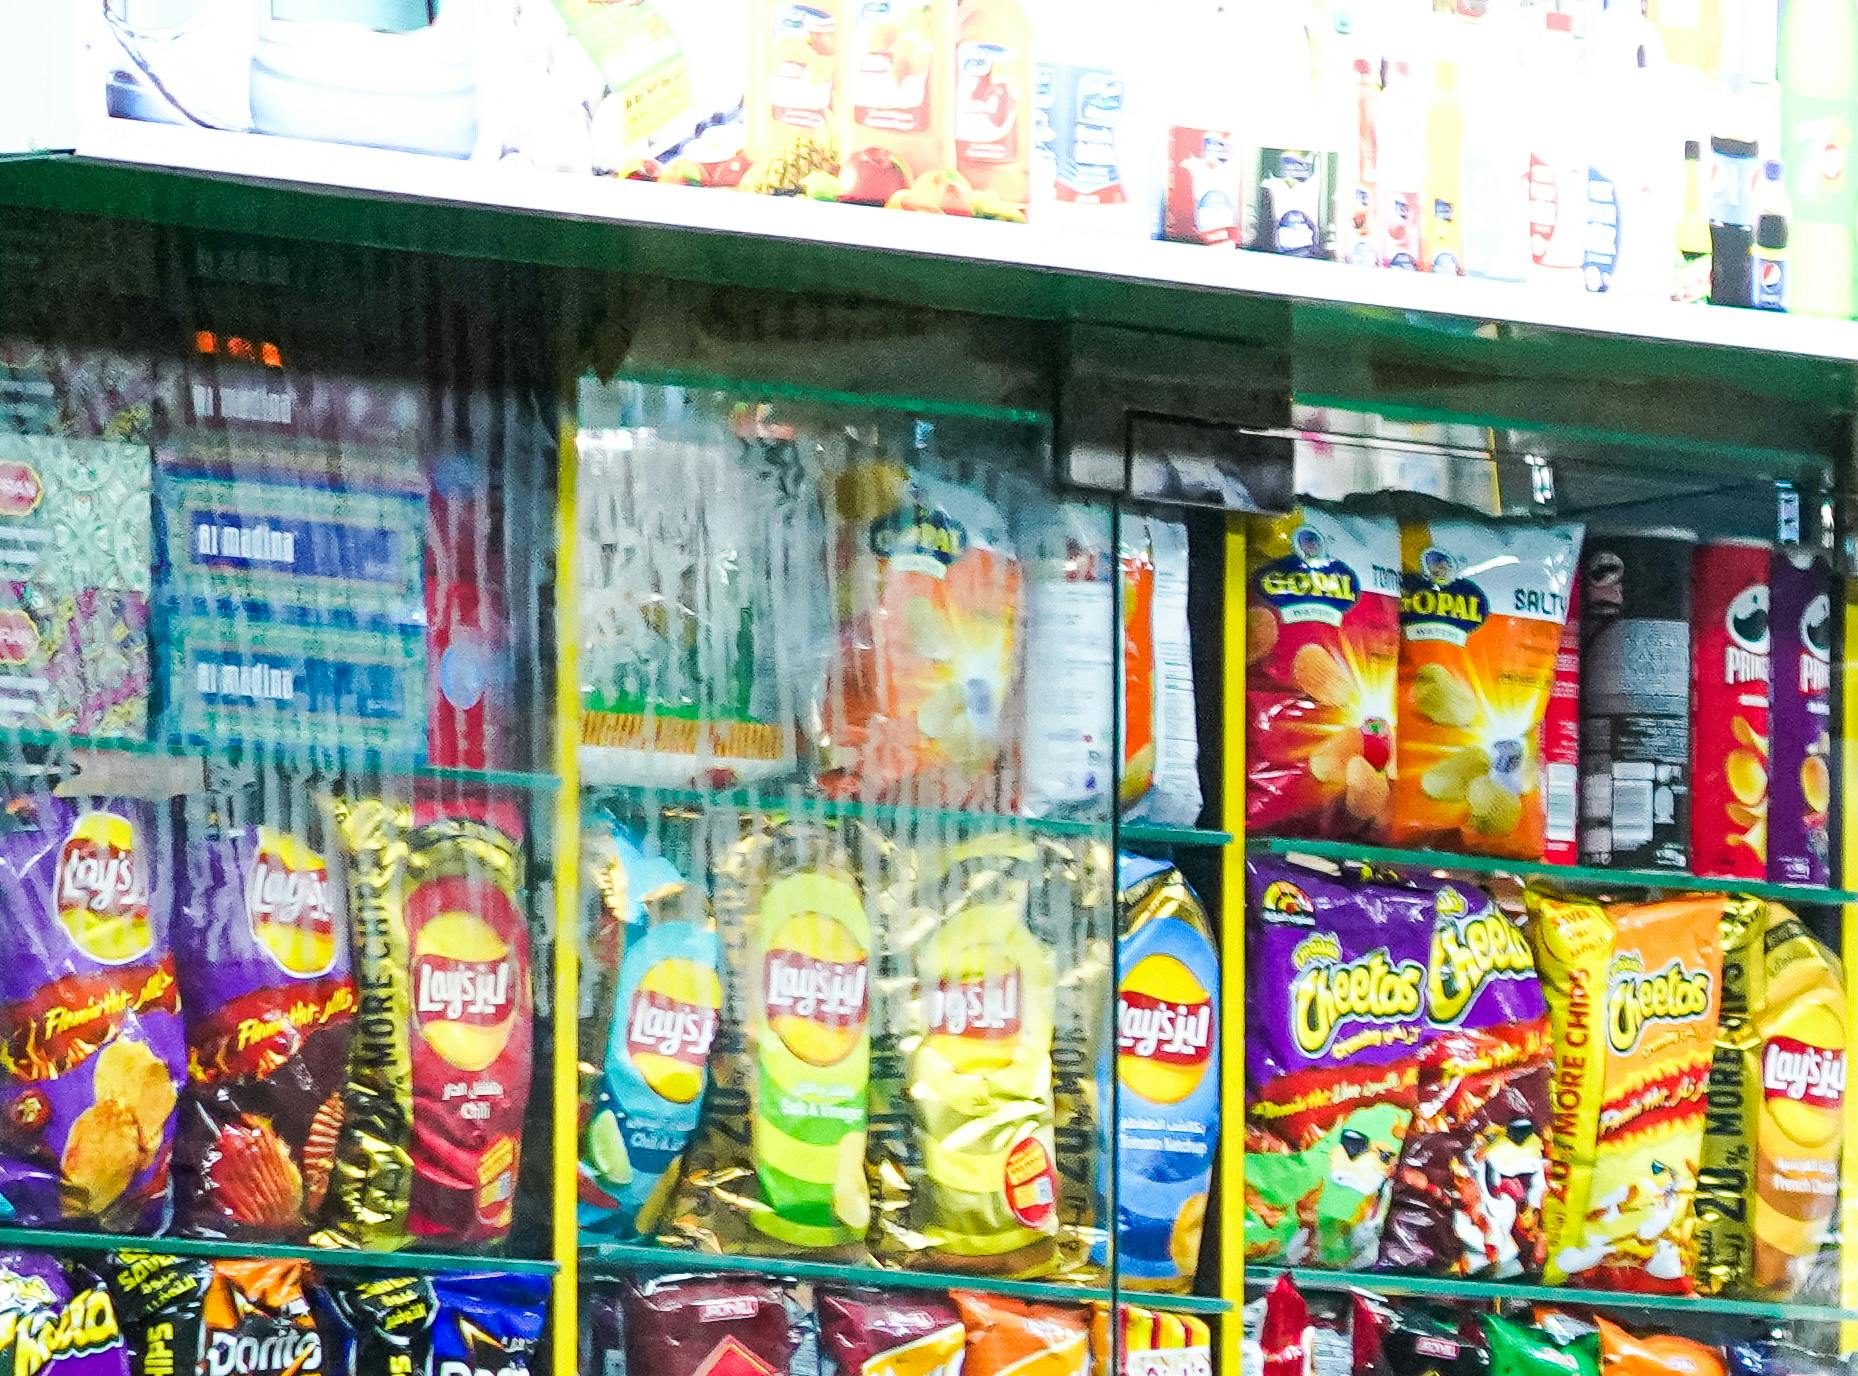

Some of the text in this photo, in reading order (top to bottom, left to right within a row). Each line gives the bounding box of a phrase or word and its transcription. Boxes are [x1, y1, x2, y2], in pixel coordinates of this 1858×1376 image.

[1262, 568, 1354, 603] GOPAL
[1296, 955, 1425, 1058] Cheetos
[1427, 903, 1532, 1026] Cheeto
[1557, 966, 1591, 1131] MORE CHIPS
[1606, 966, 1709, 1055] Cheetos
[1709, 1047, 1745, 1136] MORE
[1764, 1043, 1821, 1100] Lay's
